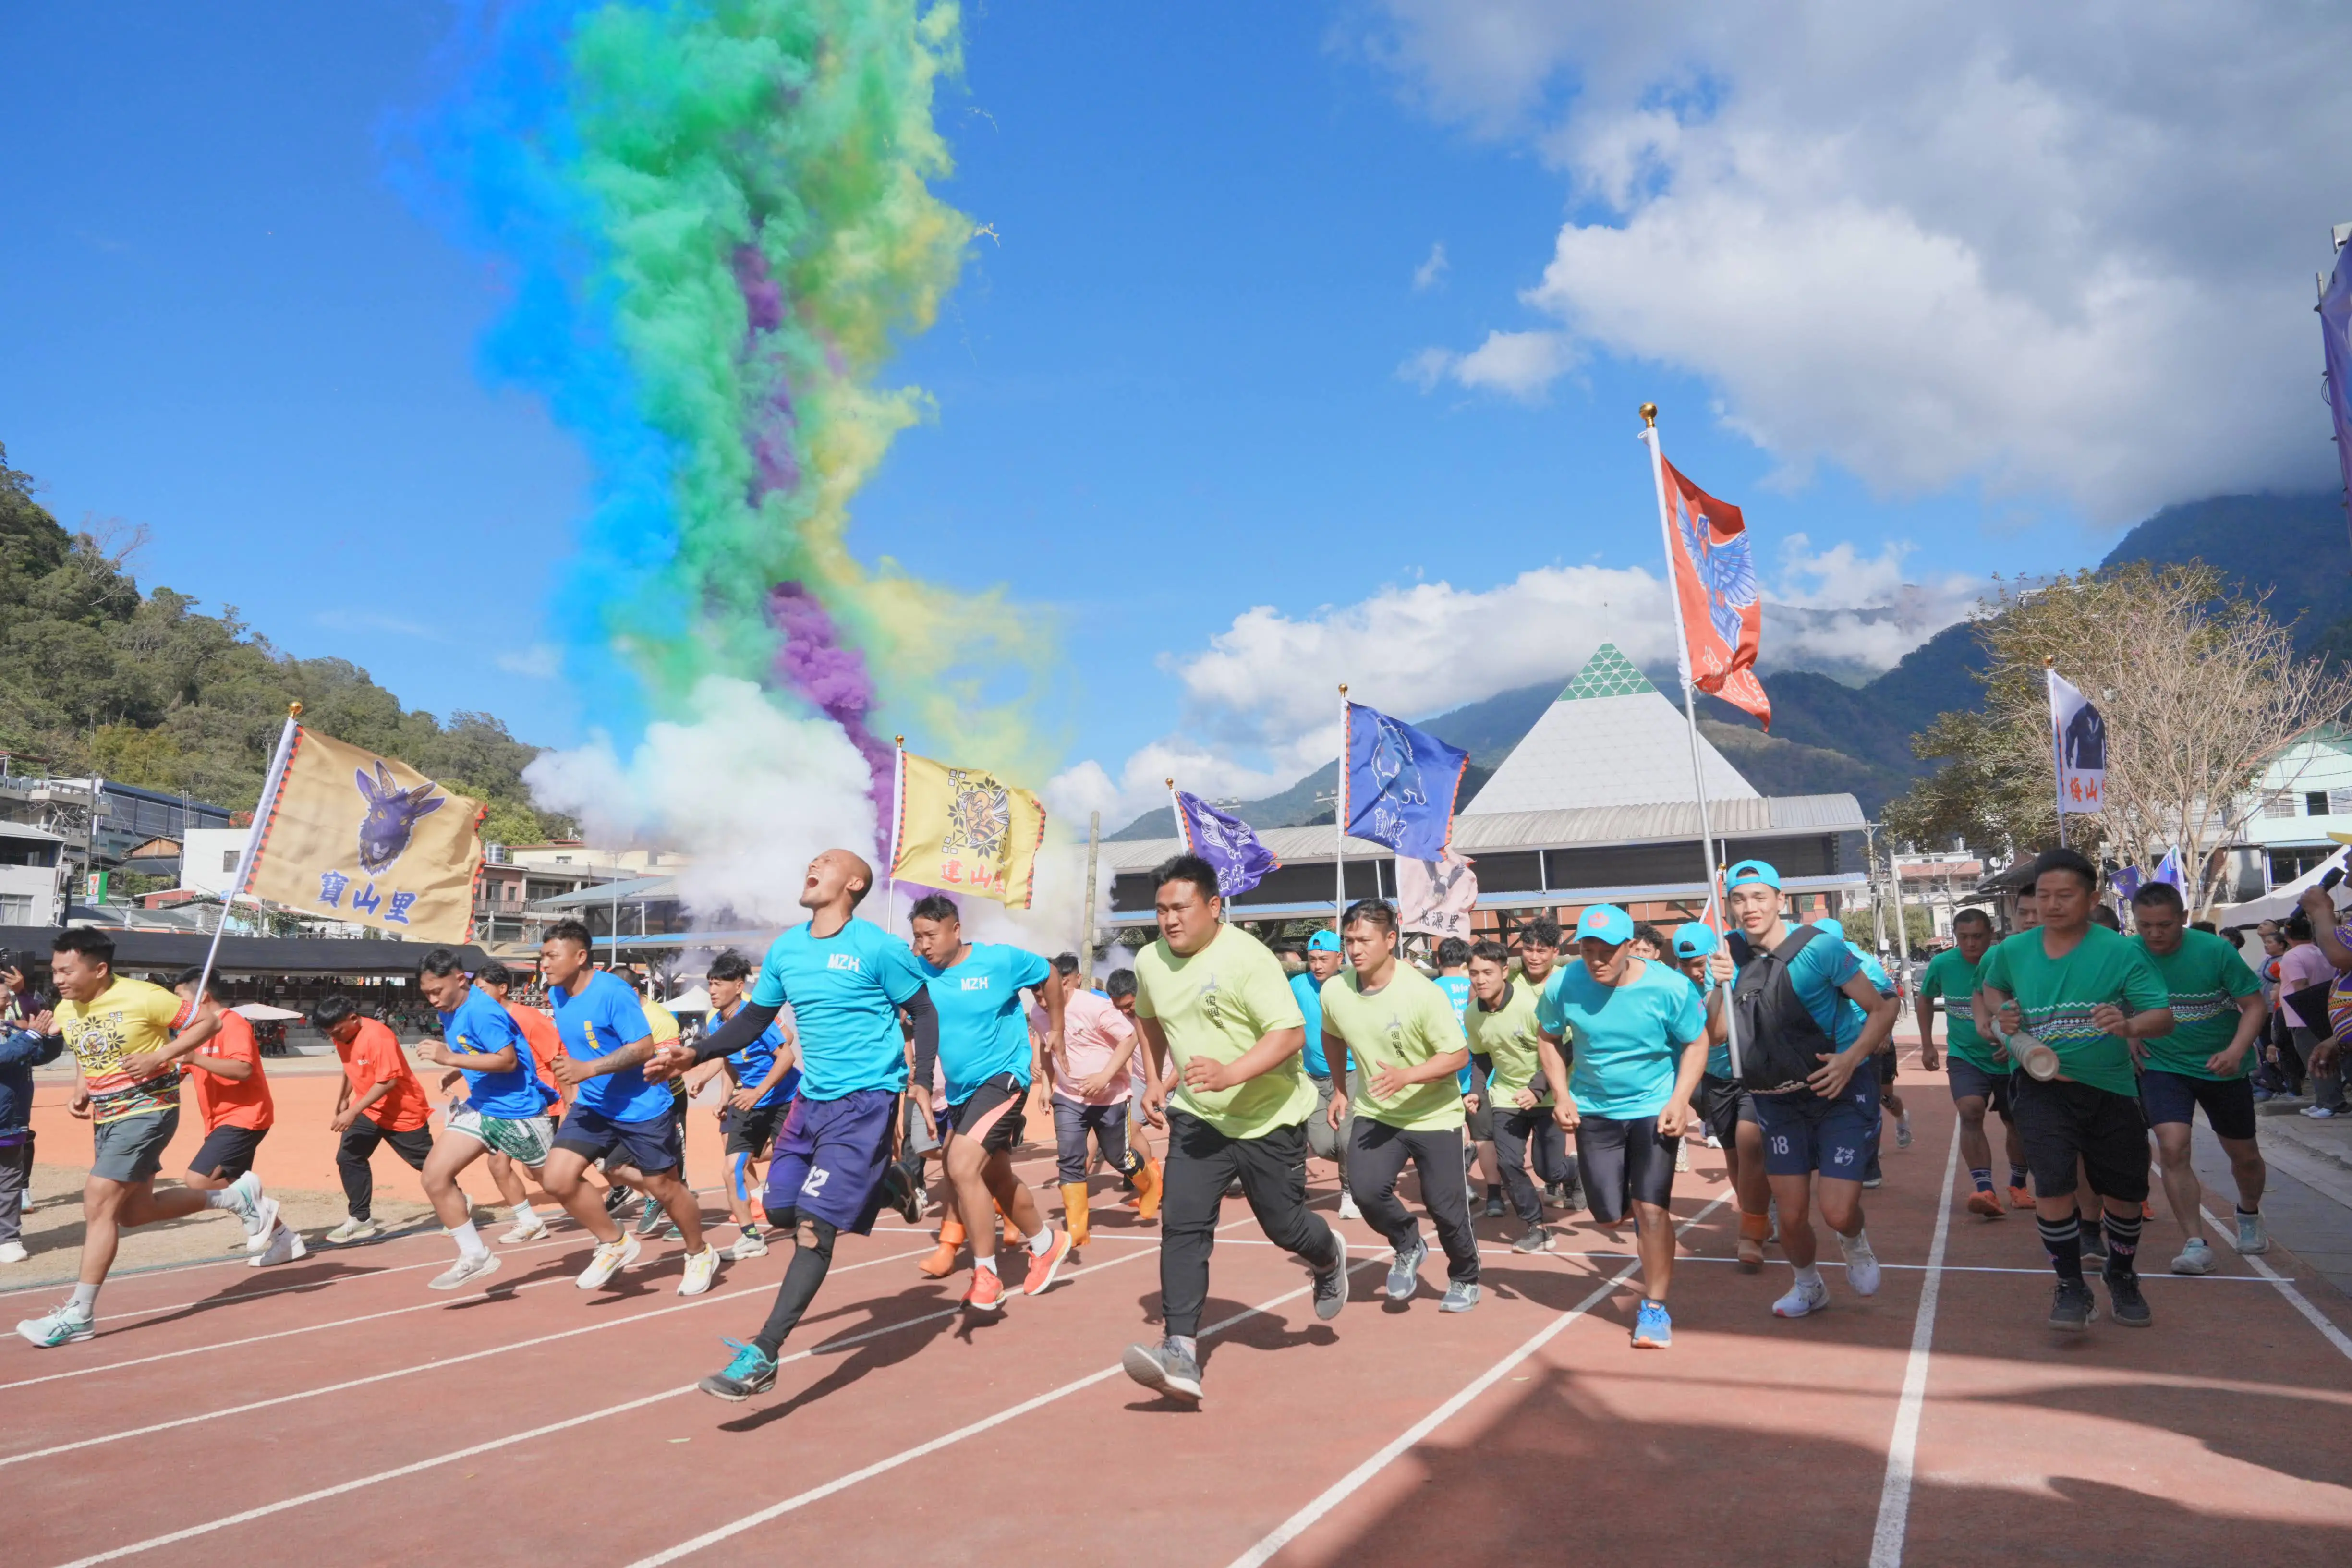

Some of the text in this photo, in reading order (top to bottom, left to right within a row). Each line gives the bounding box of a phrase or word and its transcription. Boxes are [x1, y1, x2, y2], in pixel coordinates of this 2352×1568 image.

[316, 870, 418, 925] 寶山里
[827, 953, 860, 972] MZH
[961, 976, 989, 991] MZH
[1205, 995, 1225, 1029] 復興里
[1770, 1135, 1789, 1155] 18
[801, 1165, 830, 1197] 12
